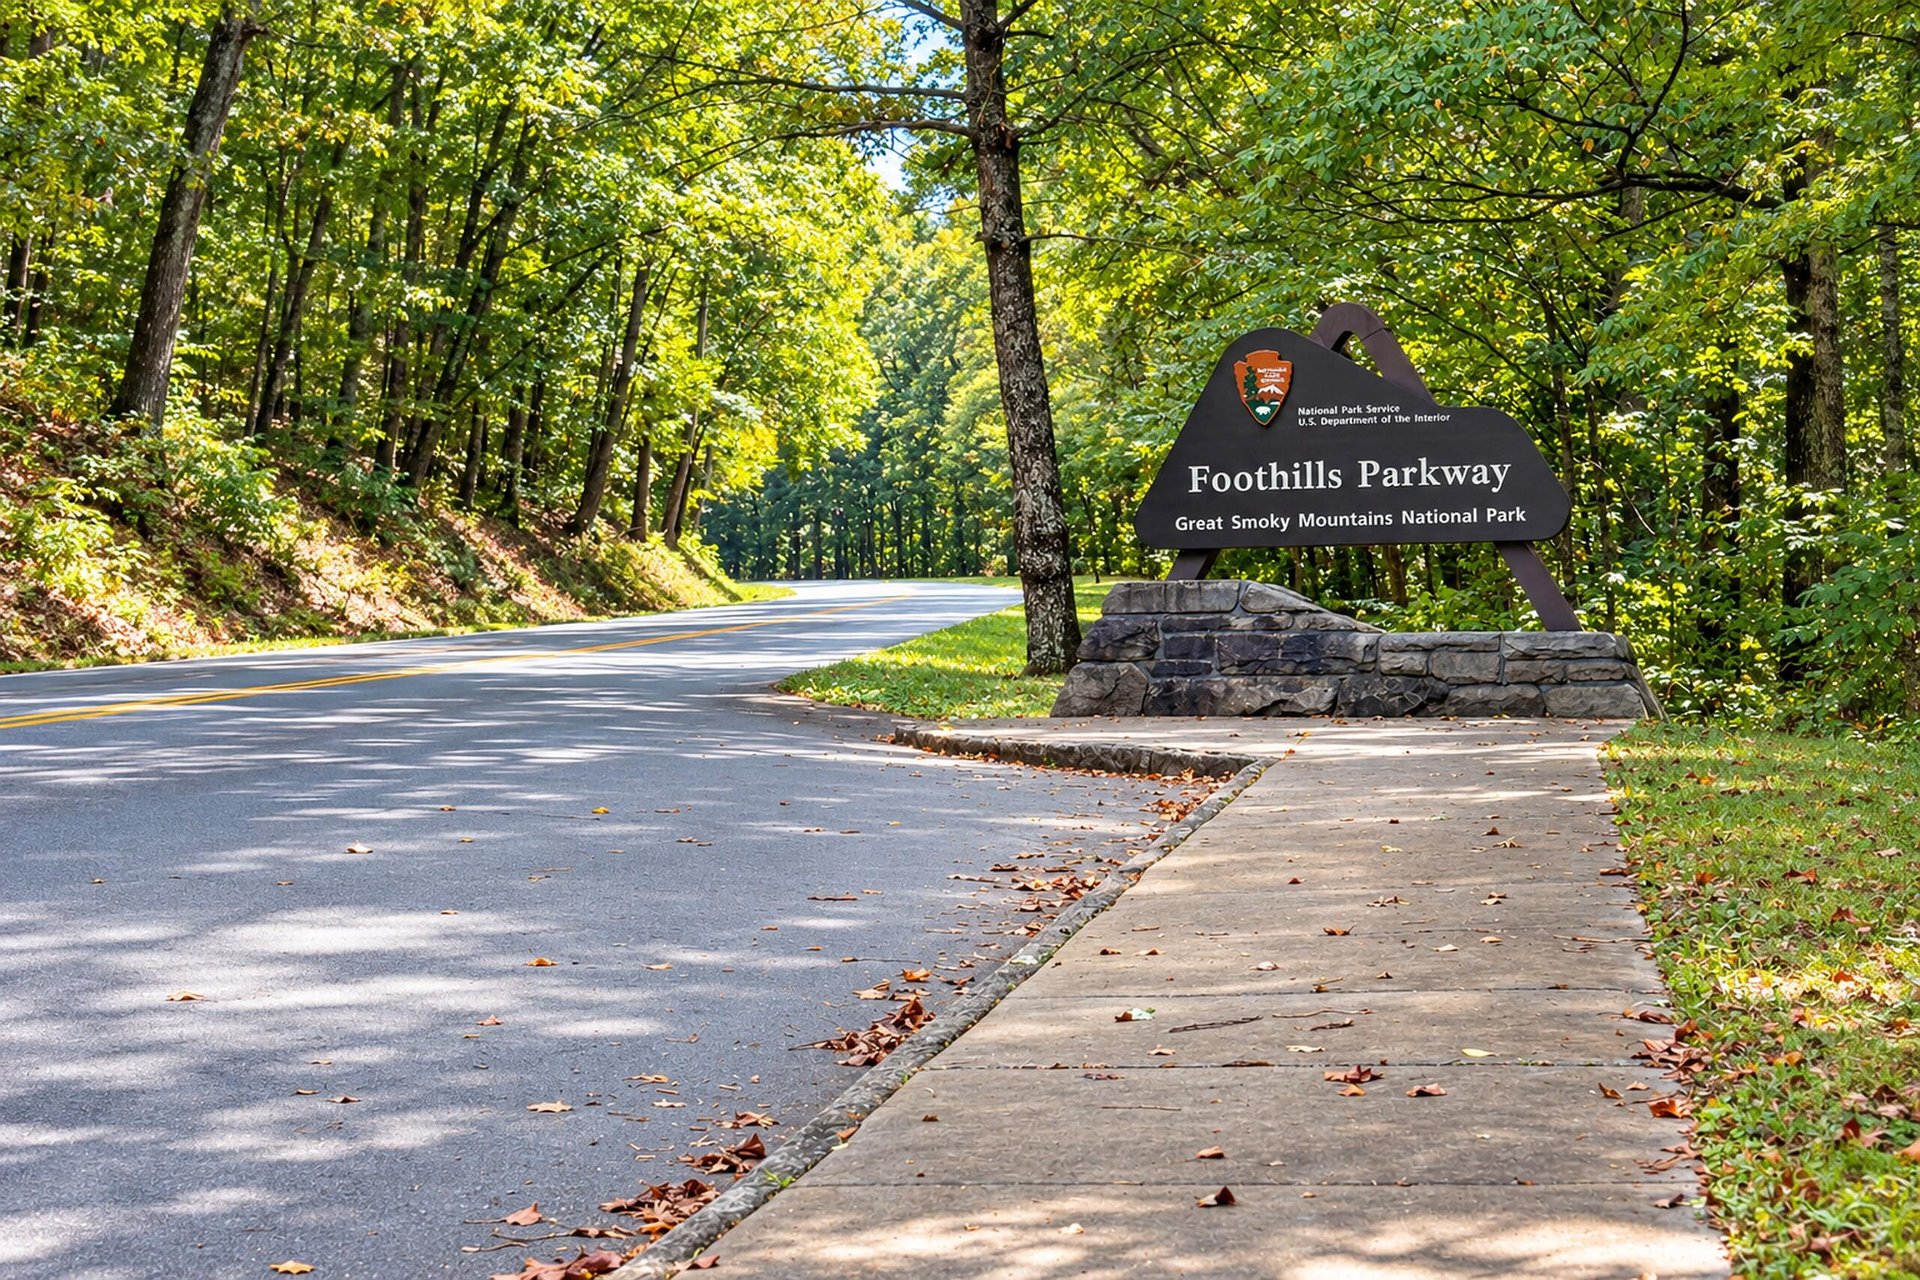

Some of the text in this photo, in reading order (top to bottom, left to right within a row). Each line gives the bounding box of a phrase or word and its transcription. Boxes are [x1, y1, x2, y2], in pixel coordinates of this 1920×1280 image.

[1297, 404, 1401, 416] National Park Service
[1298, 413, 1451, 427] U.S. Department of the Interior
[1188, 457, 1512, 493] Foothills Parkway
[1175, 507, 1527, 532] Great Smoky Mountains National Park
